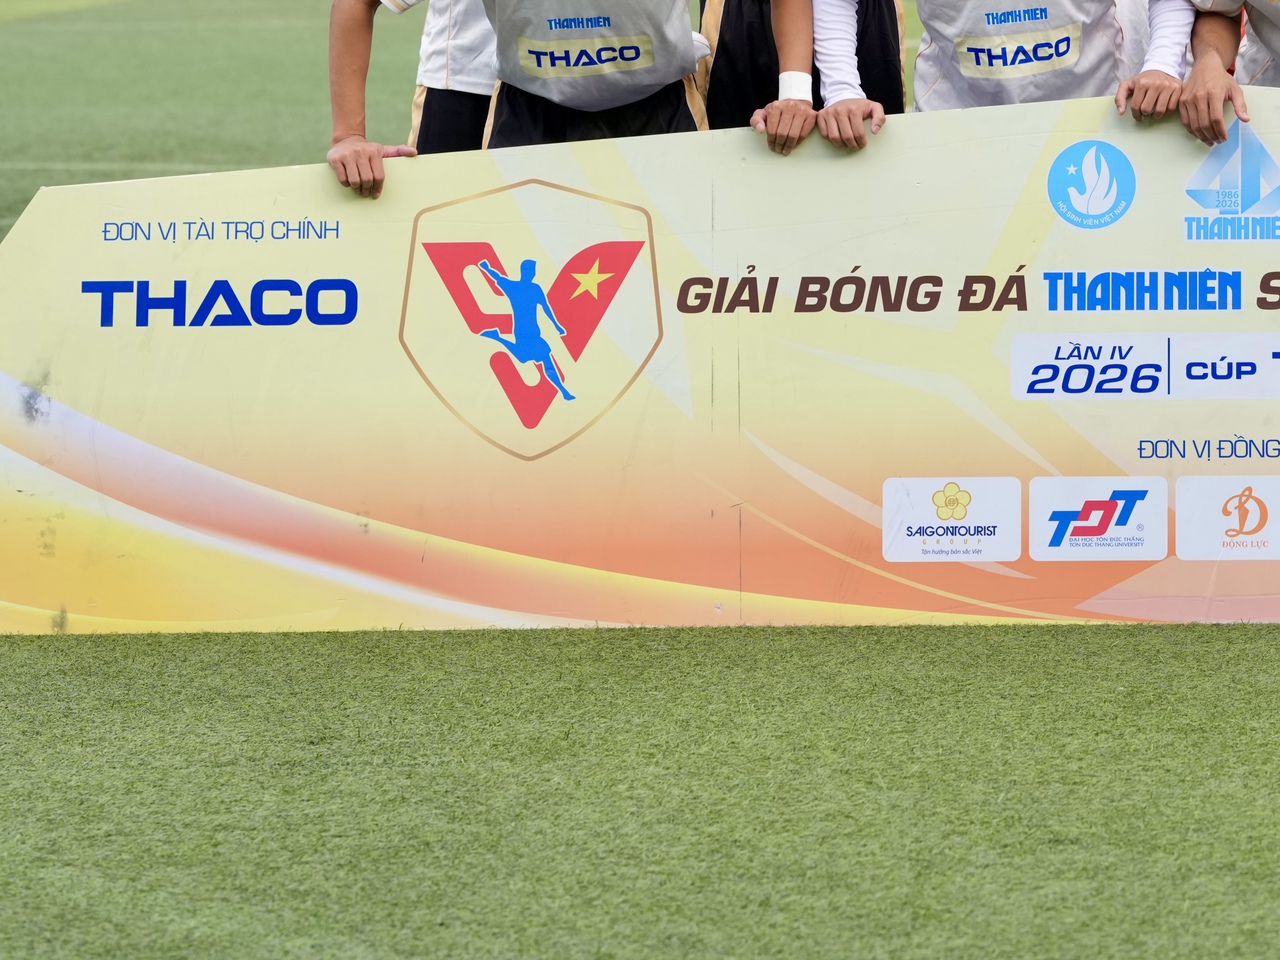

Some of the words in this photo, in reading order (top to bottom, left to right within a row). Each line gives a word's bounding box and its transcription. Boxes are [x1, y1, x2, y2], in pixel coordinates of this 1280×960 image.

[546, 17, 585, 30] THANH
[984, 10, 1022, 25] THANH
[527, 45, 641, 68] THACO
[966, 36, 1071, 67] THACO
[1215, 191, 1240, 199] 1986
[1215, 199, 1240, 208] 2026
[1056, 200, 1068, 213] HỘI
[1066, 211, 1081, 223] SINH
[1083, 217, 1099, 226] VIÊN
[1099, 213, 1115, 224] VIỆT
[1113, 200, 1127, 215] NAM
[102, 221, 151, 241] ĐƠN
[158, 222, 177, 243] VỊ
[183, 217, 215, 240] TÀI
[222, 219, 265, 243] TRỢ
[271, 216, 340, 240] CHÍNH
[1184, 217, 1251, 240] THANH
[676, 265, 780, 314] GIẢI
[793, 265, 943, 313] BÓNG
[957, 265, 1028, 312] ĐÁ
[1043, 271, 1159, 311] THANH
[1164, 268, 1242, 311] NIÊN
[81, 278, 358, 327] THACO
[1054, 341, 1103, 361] LẦN
[1109, 345, 1134, 360] IV
[1026, 363, 1163, 394] 2026
[1185, 355, 1258, 381] CÚP
[1137, 439, 1186, 459] ĐƠN
[1192, 439, 1211, 461] VỊ
[1216, 433, 1280, 459] ĐỒNG
[906, 525, 998, 537] SAIGONTOURIST
[1222, 539, 1248, 549] ĐỘNG
[1250, 539, 1269, 549] LỰC
